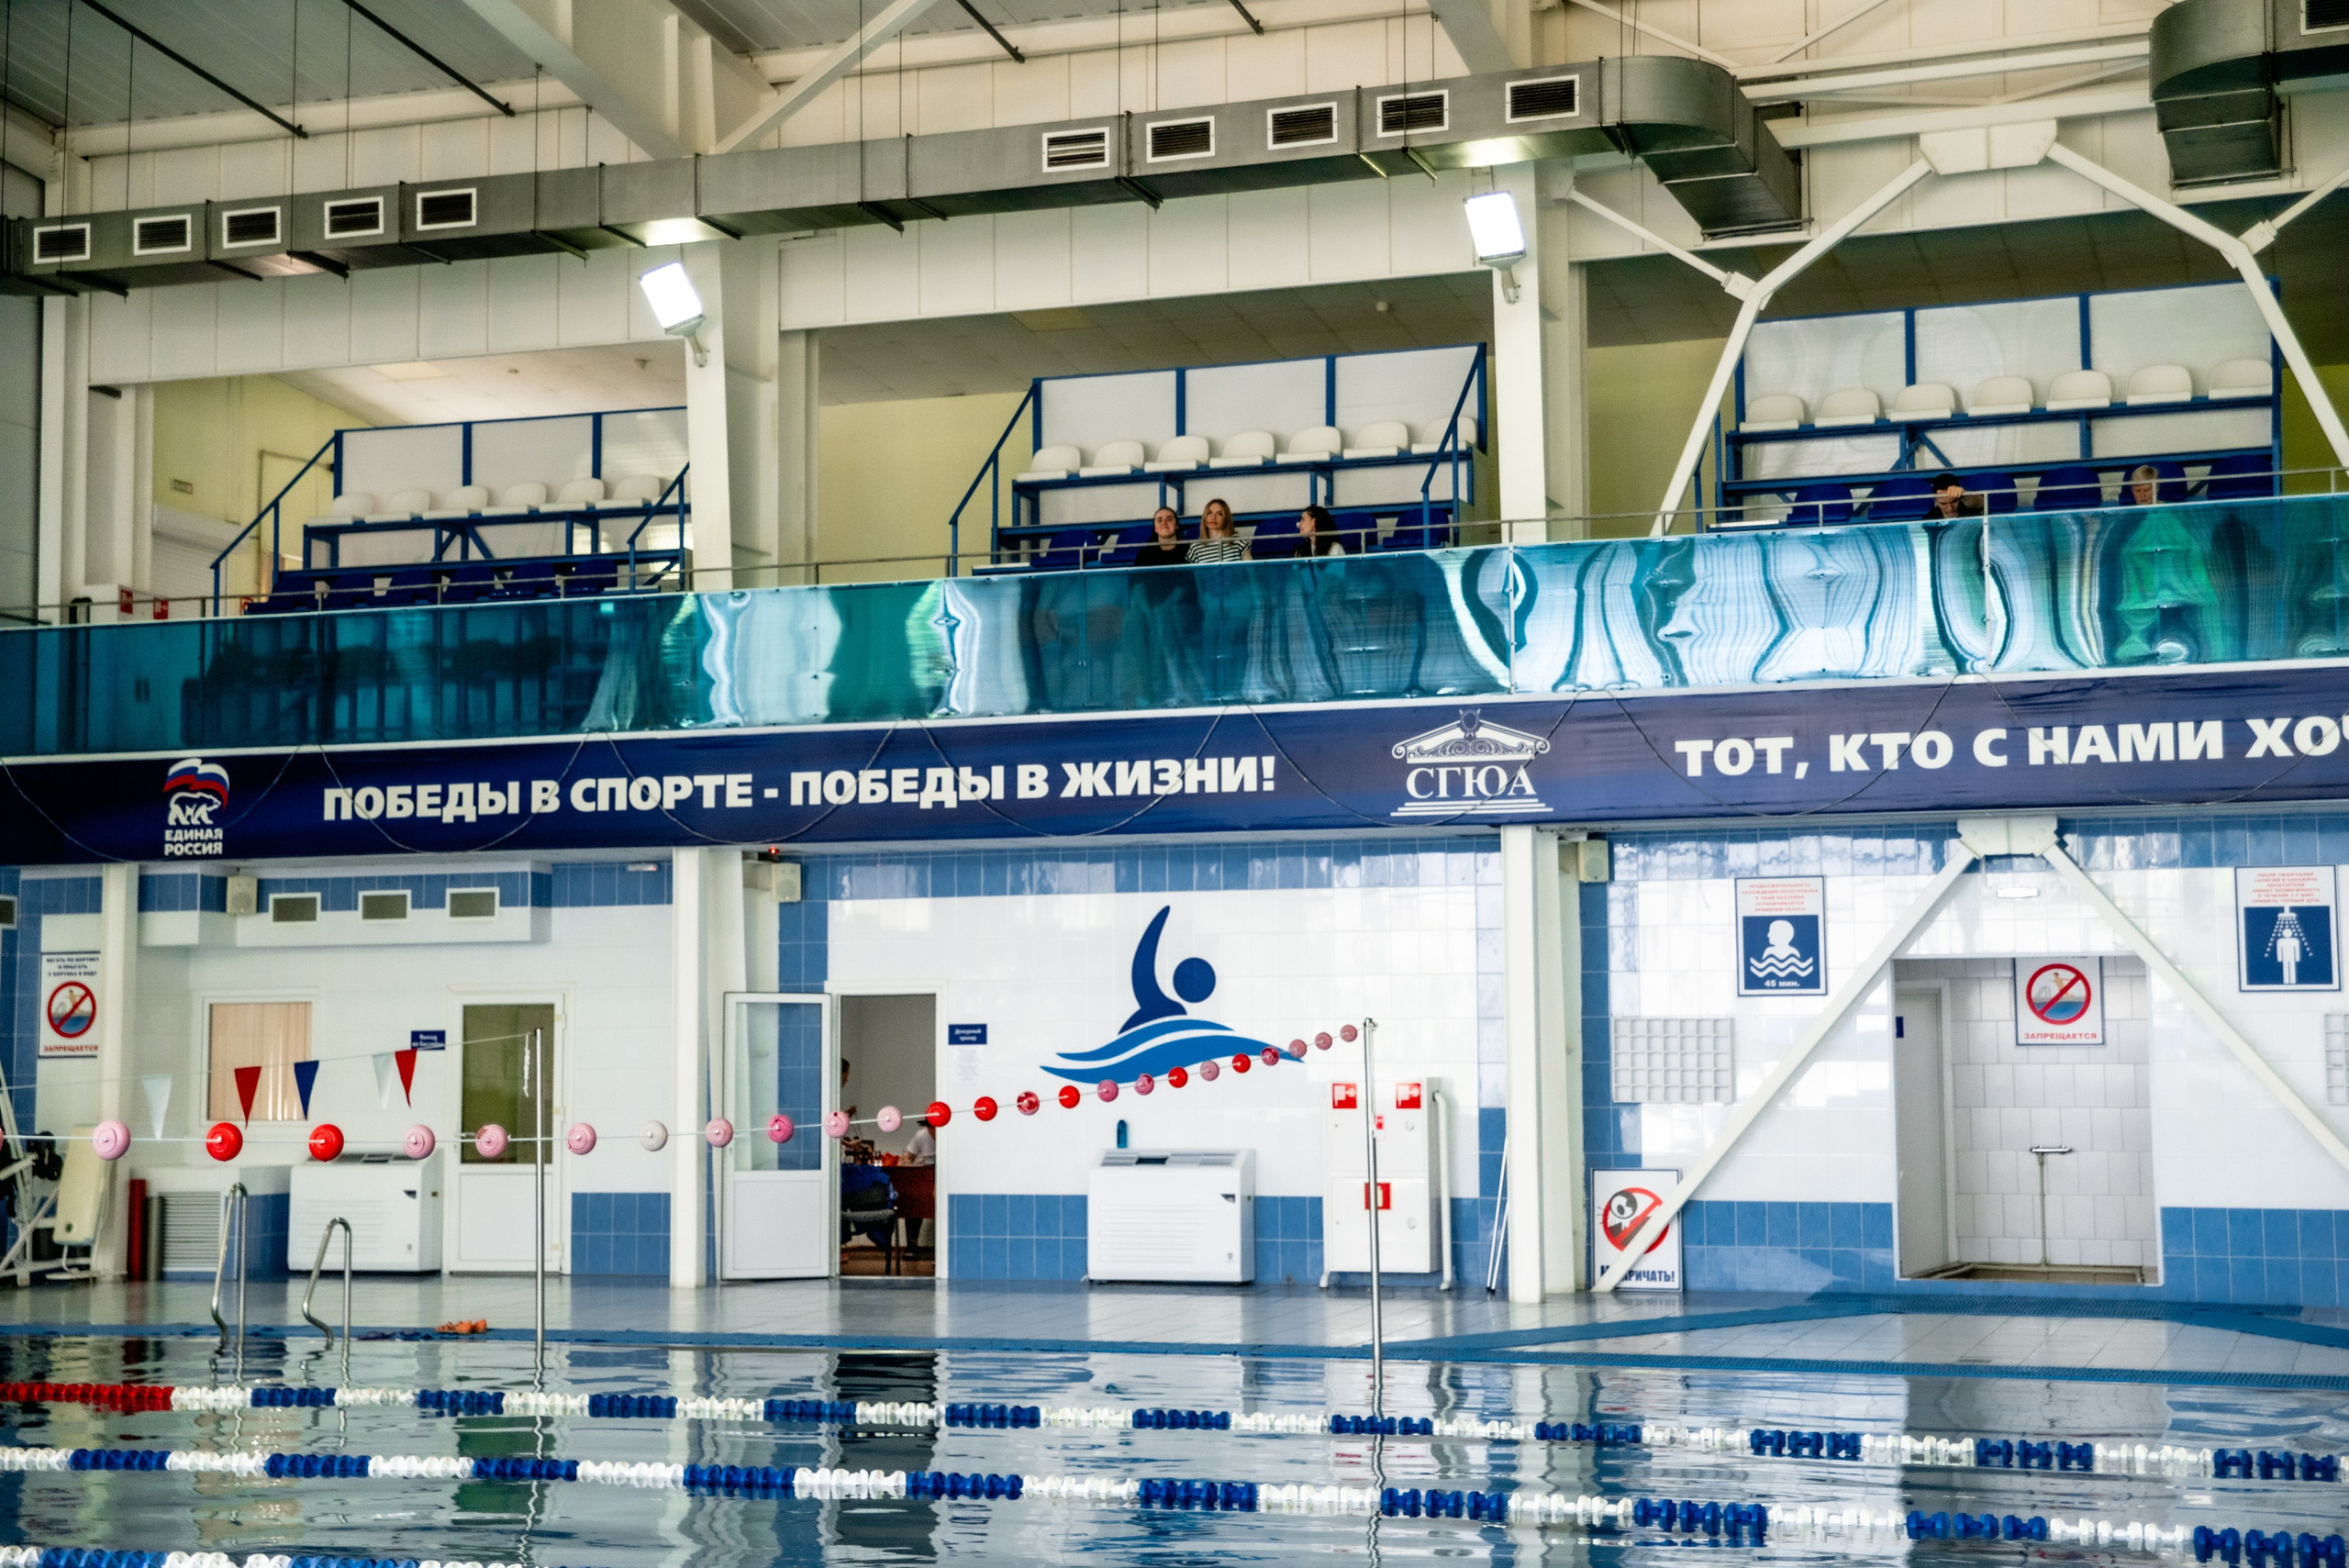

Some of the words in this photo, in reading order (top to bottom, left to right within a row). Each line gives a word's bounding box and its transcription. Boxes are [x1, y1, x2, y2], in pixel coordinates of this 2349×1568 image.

[1675, 736, 1809, 780] ТОТ,
[1829, 730, 1954, 772] КТО
[1973, 728, 2008, 767] С
[2028, 720, 2223, 766] НАМИ
[2245, 714, 2349, 758] ХО
[1407, 764, 1537, 799] СГЮА
[323, 782, 520, 823] ПОБЕДЫ
[531, 781, 561, 814] В
[570, 773, 753, 812] СПОРТЕ
[763, 787, 779, 798] -
[790, 766, 1005, 809] ПОБЕДЫ
[1017, 764, 1050, 799] В
[1060, 756, 1275, 798] ЖИЗНИ!
[164, 828, 223, 842] ЕДИНАЯ
[164, 841, 223, 856] РОССИЯ
[1764, 979, 1776, 987] 45
[2024, 1032, 2098, 1040] ЗАПРЕЩАЕТСЯ
[43, 1044, 99, 1052] ЗАПРЕЩАЕТСЯ
